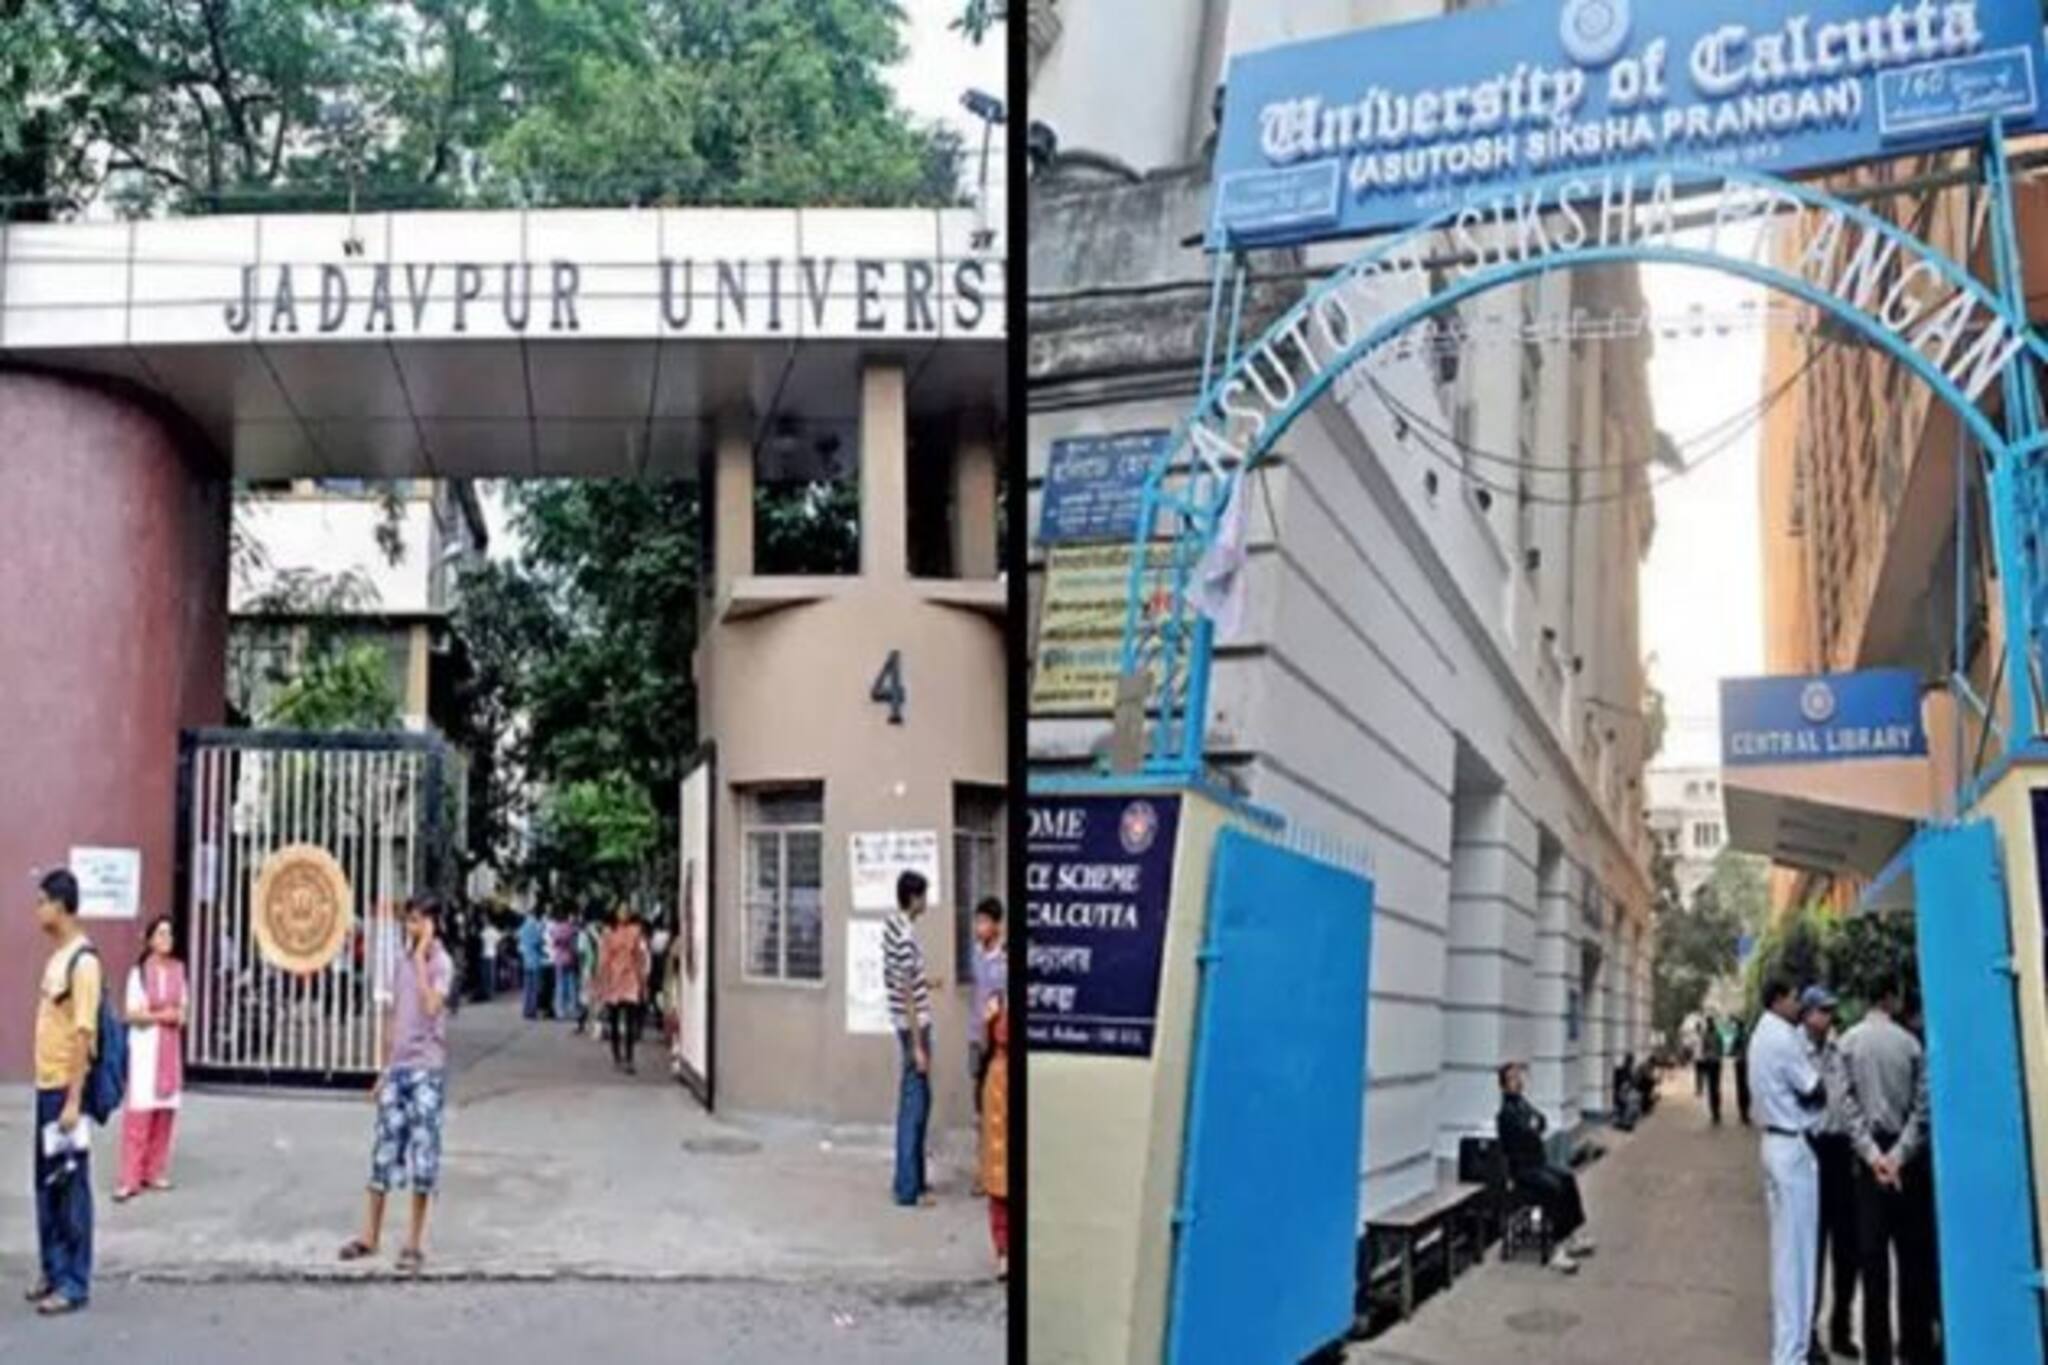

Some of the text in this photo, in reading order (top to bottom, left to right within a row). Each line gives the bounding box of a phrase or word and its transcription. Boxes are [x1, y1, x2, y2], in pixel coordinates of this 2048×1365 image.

[1259, 0, 1984, 162] University of Calcutta
[1350, 134, 1517, 191] (ASUTOSH
[1527, 113, 1655, 161] SIKSHA
[1662, 79, 1863, 141] PRANGAN)
[225, 255, 1008, 334] JADAVPUR UNIVERS
[1189, 171, 2022, 479] ASUTOH SIKSHA PRANGAN
[870, 649, 906, 726] 4
[1731, 725, 1912, 754] CENTRAL LIBRARY
[1027, 902, 1139, 928] CALCUTTA
[1056, 863, 1141, 893] SCHEME
